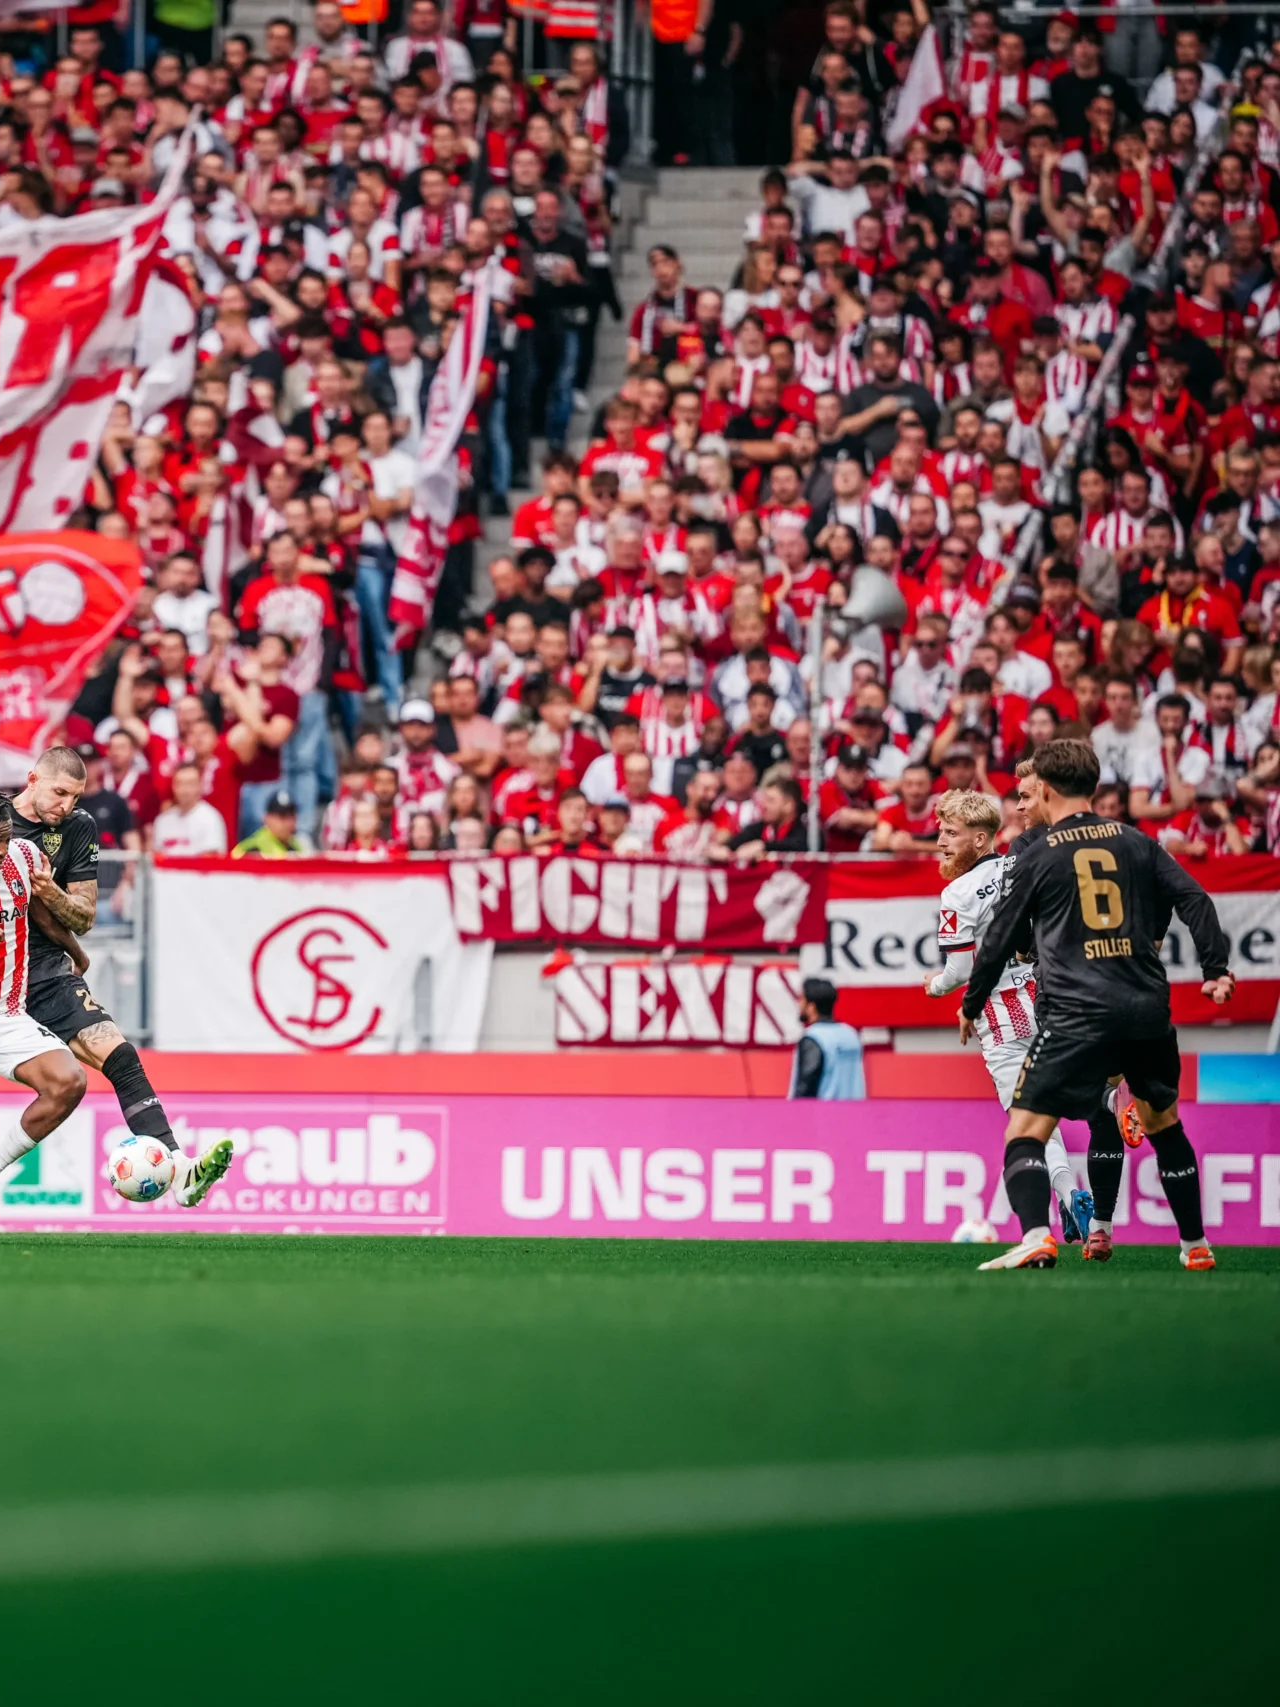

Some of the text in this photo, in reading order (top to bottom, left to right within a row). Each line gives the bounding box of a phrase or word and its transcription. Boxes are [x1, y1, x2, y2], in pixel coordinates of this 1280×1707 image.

[1046, 822, 1123, 847] STUTTGART
[449, 856, 727, 941] FIGHT
[1073, 848, 1124, 930] 6
[1084, 938, 1132, 960] STILLER
[555, 963, 807, 1043] SEXIS
[1092, 1151, 1123, 1160] JAKO
[1160, 1166, 1195, 1179] JAKO
[501, 1147, 834, 1223] UNSER
